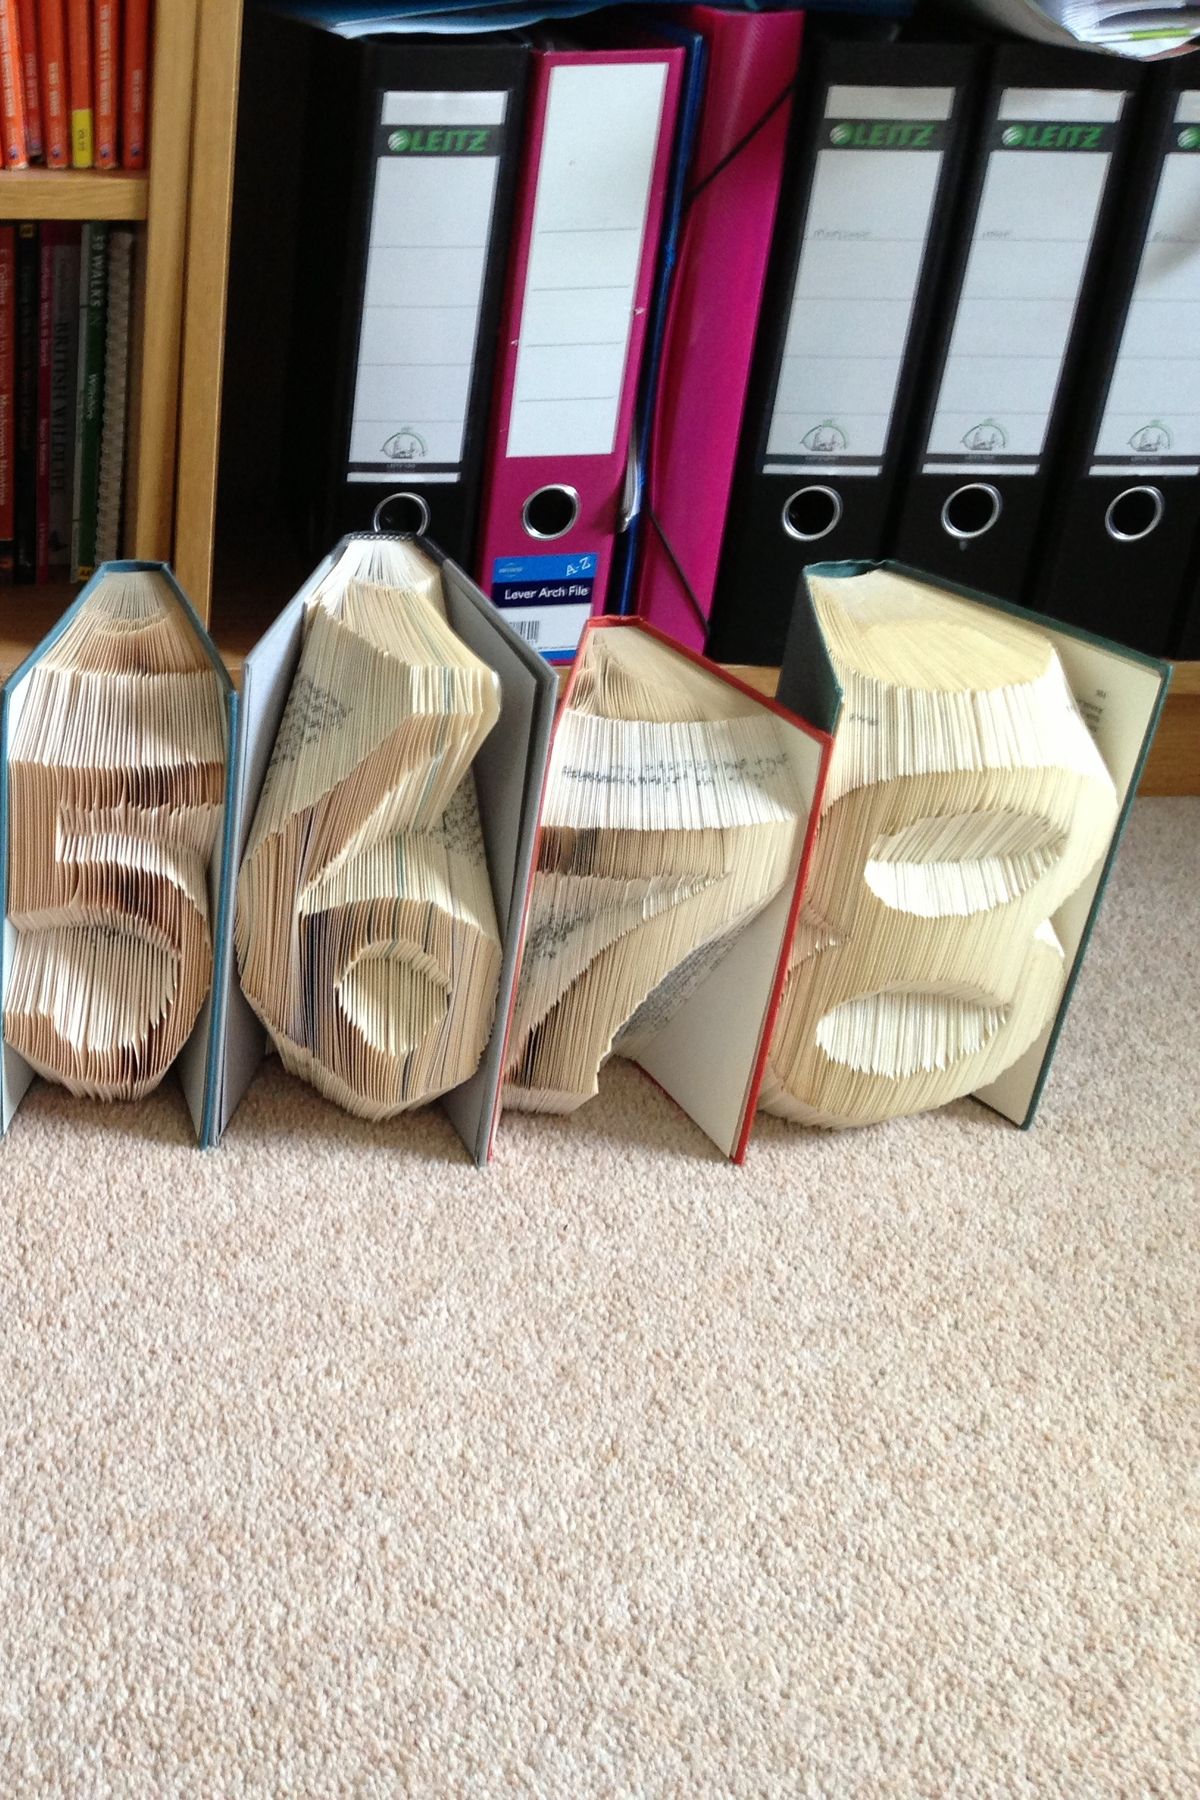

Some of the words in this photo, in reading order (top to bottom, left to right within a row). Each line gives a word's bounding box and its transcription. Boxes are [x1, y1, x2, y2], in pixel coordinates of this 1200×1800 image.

[409, 129, 491, 152] LEITZ
[854, 123, 938, 146] LEITZ
[1025, 125, 1104, 148] LEITZ
[89, 254, 105, 308] WALKS
[565, 556, 592, 577] A-Z
[504, 588, 537, 600] Lever
[538, 586, 566, 598] Arch
[568, 584, 590, 597] File
